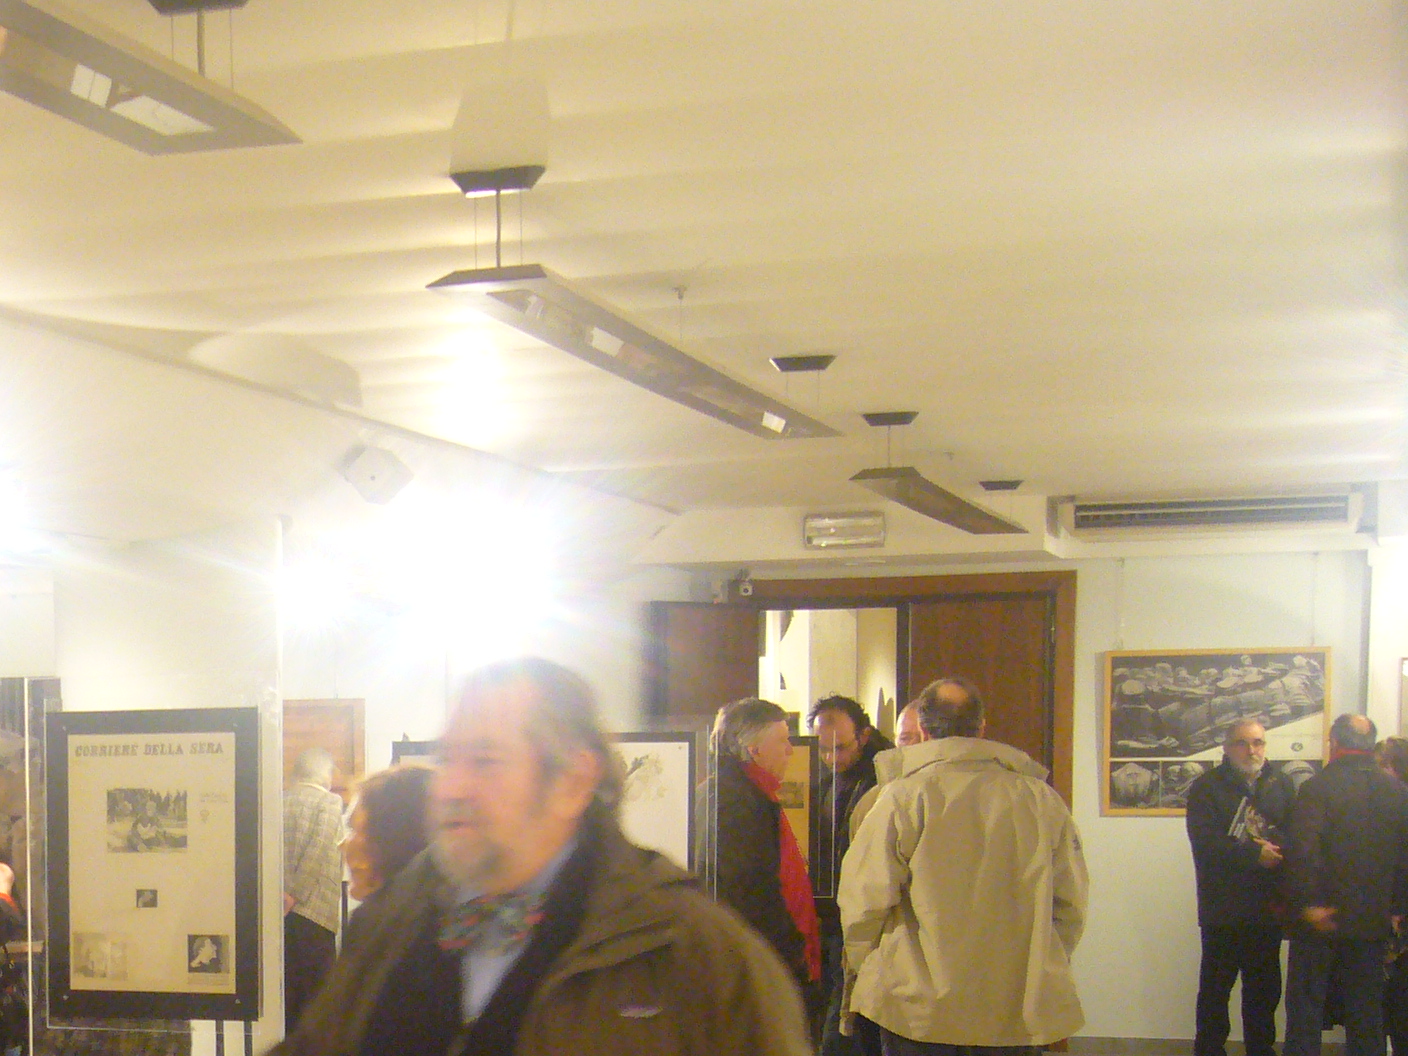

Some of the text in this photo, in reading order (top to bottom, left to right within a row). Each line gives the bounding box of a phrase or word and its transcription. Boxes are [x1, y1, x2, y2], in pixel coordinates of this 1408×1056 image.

[75, 742, 223, 757] CORRIERE DELLA SERA
